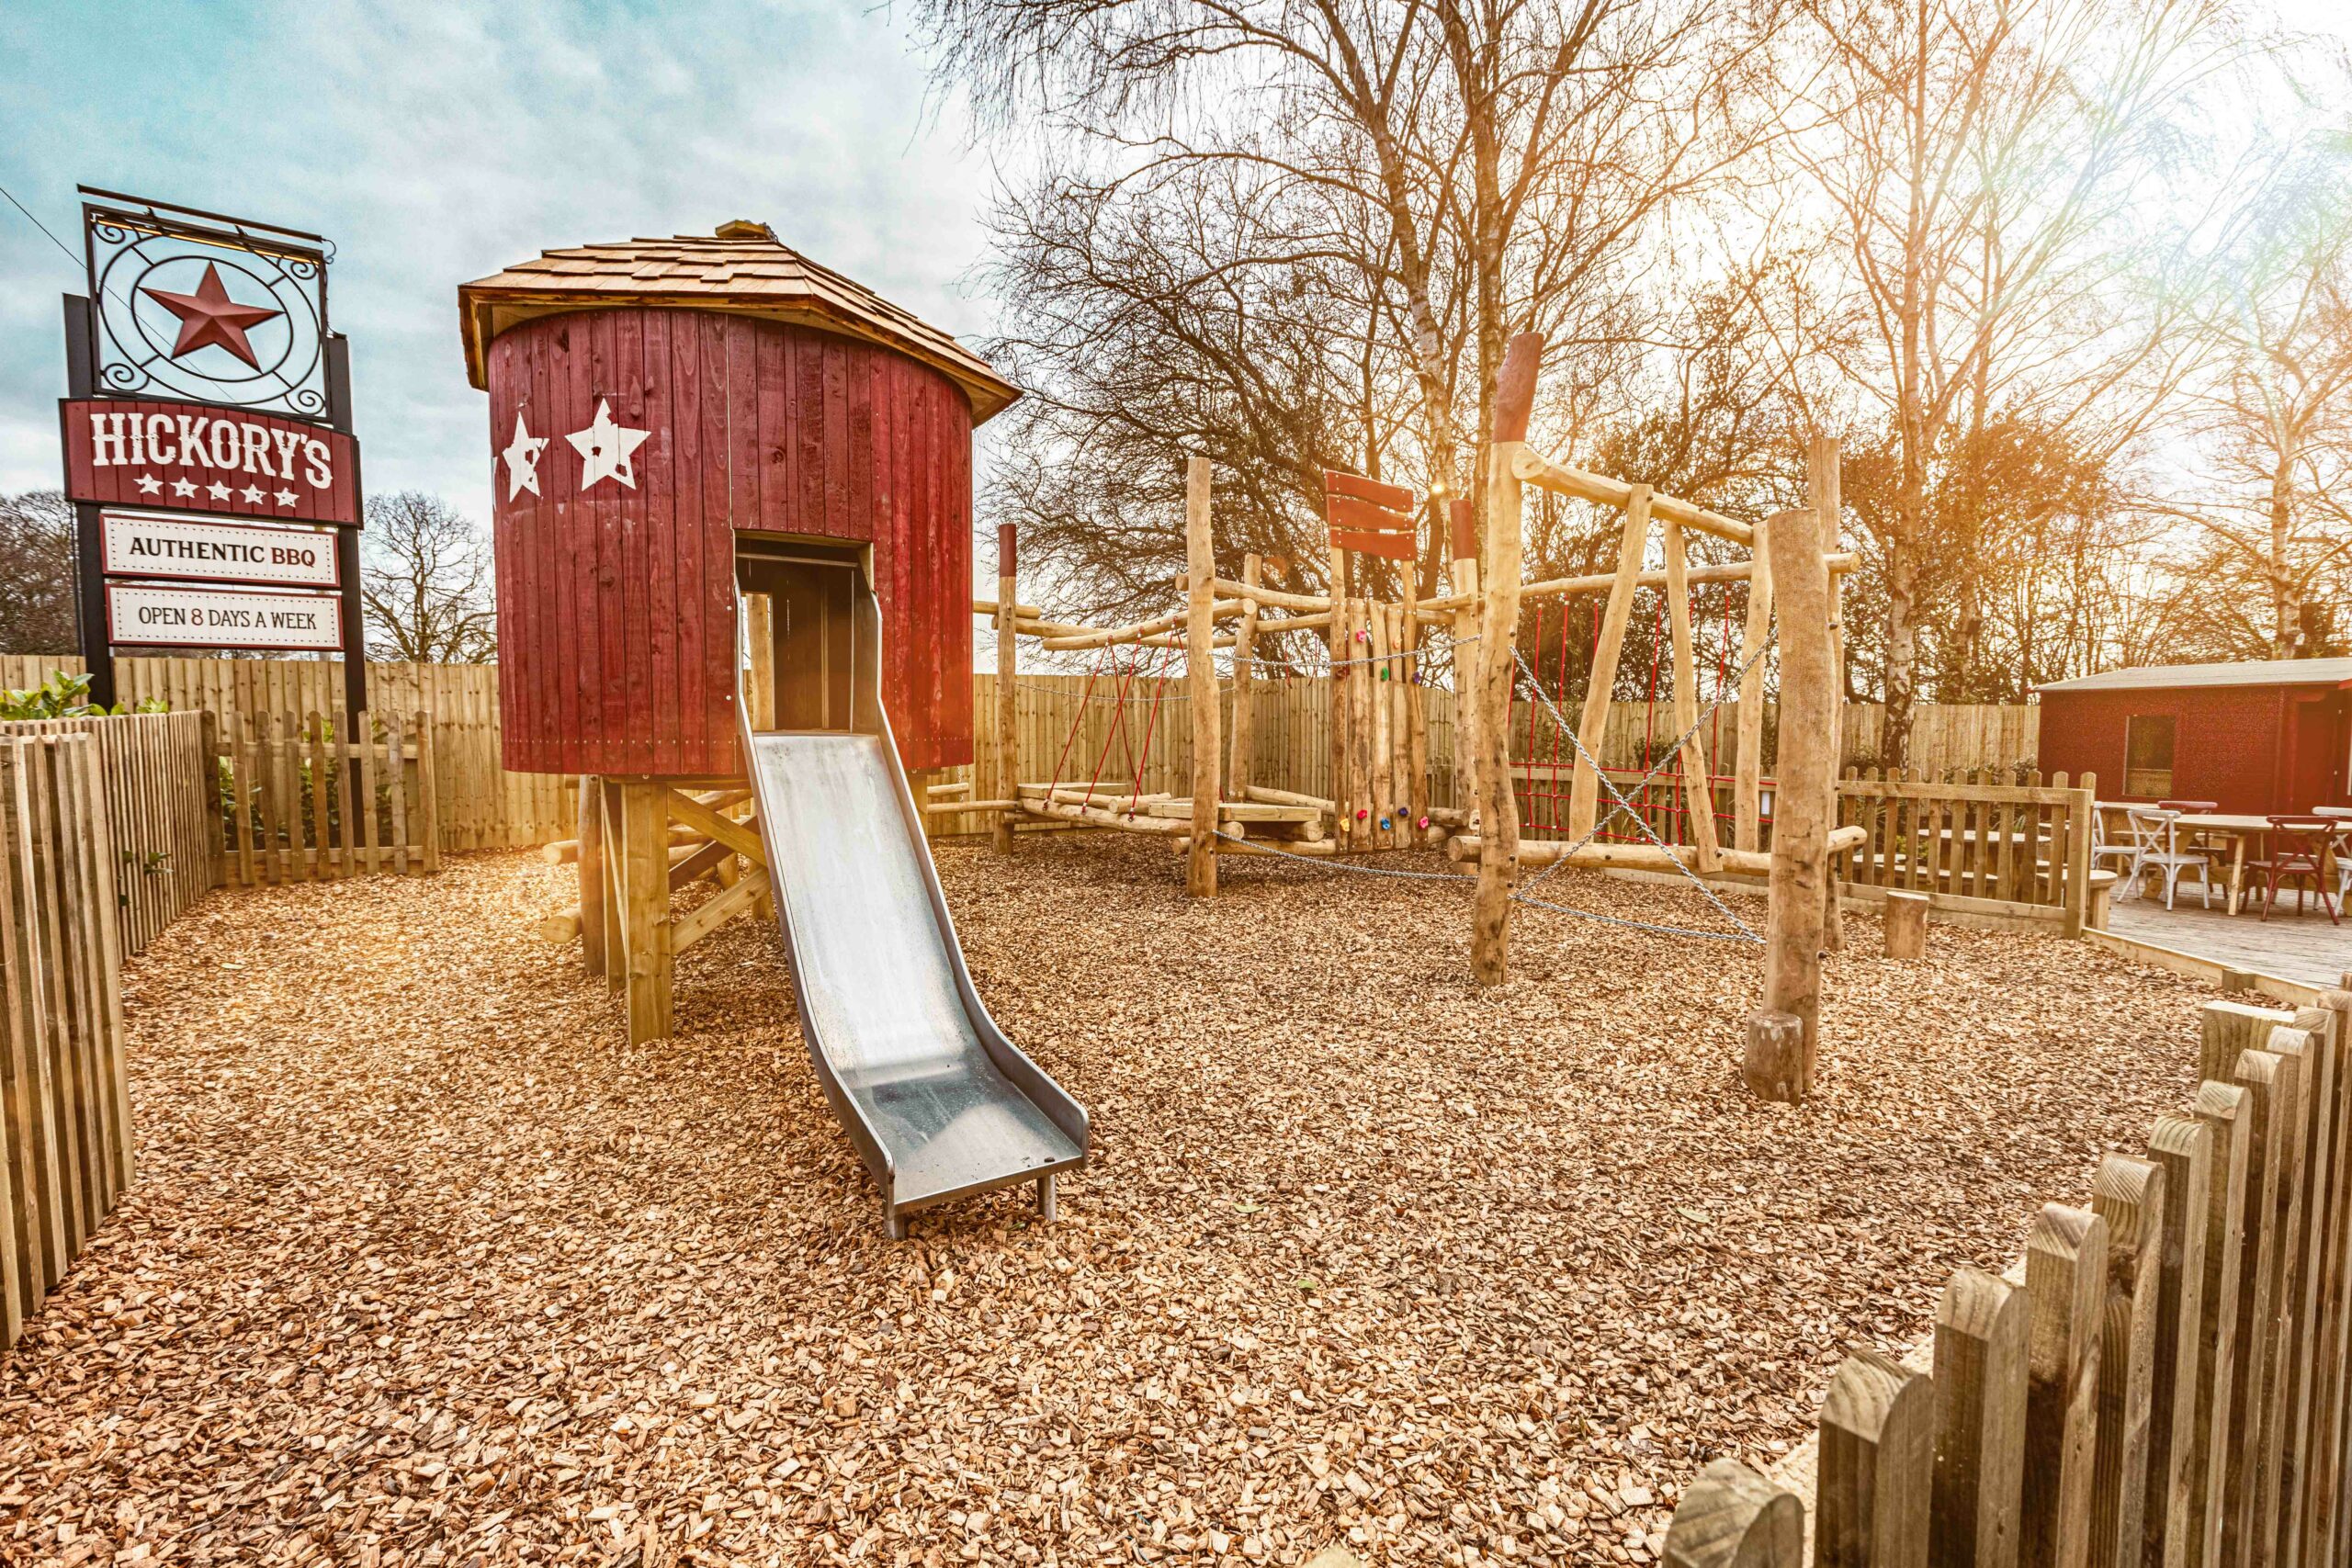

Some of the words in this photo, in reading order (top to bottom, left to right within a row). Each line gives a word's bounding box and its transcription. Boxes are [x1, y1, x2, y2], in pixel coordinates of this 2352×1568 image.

[90, 412, 334, 490] HICKORY'S
[130, 536, 266, 564] AUTHENTIC
[271, 547, 316, 568] BBQ
[139, 606, 187, 626] OPEN
[191, 608, 204, 626] 8
[209, 609, 251, 628] DAYS
[254, 611, 267, 629] A
[271, 612, 317, 630] WEEK
